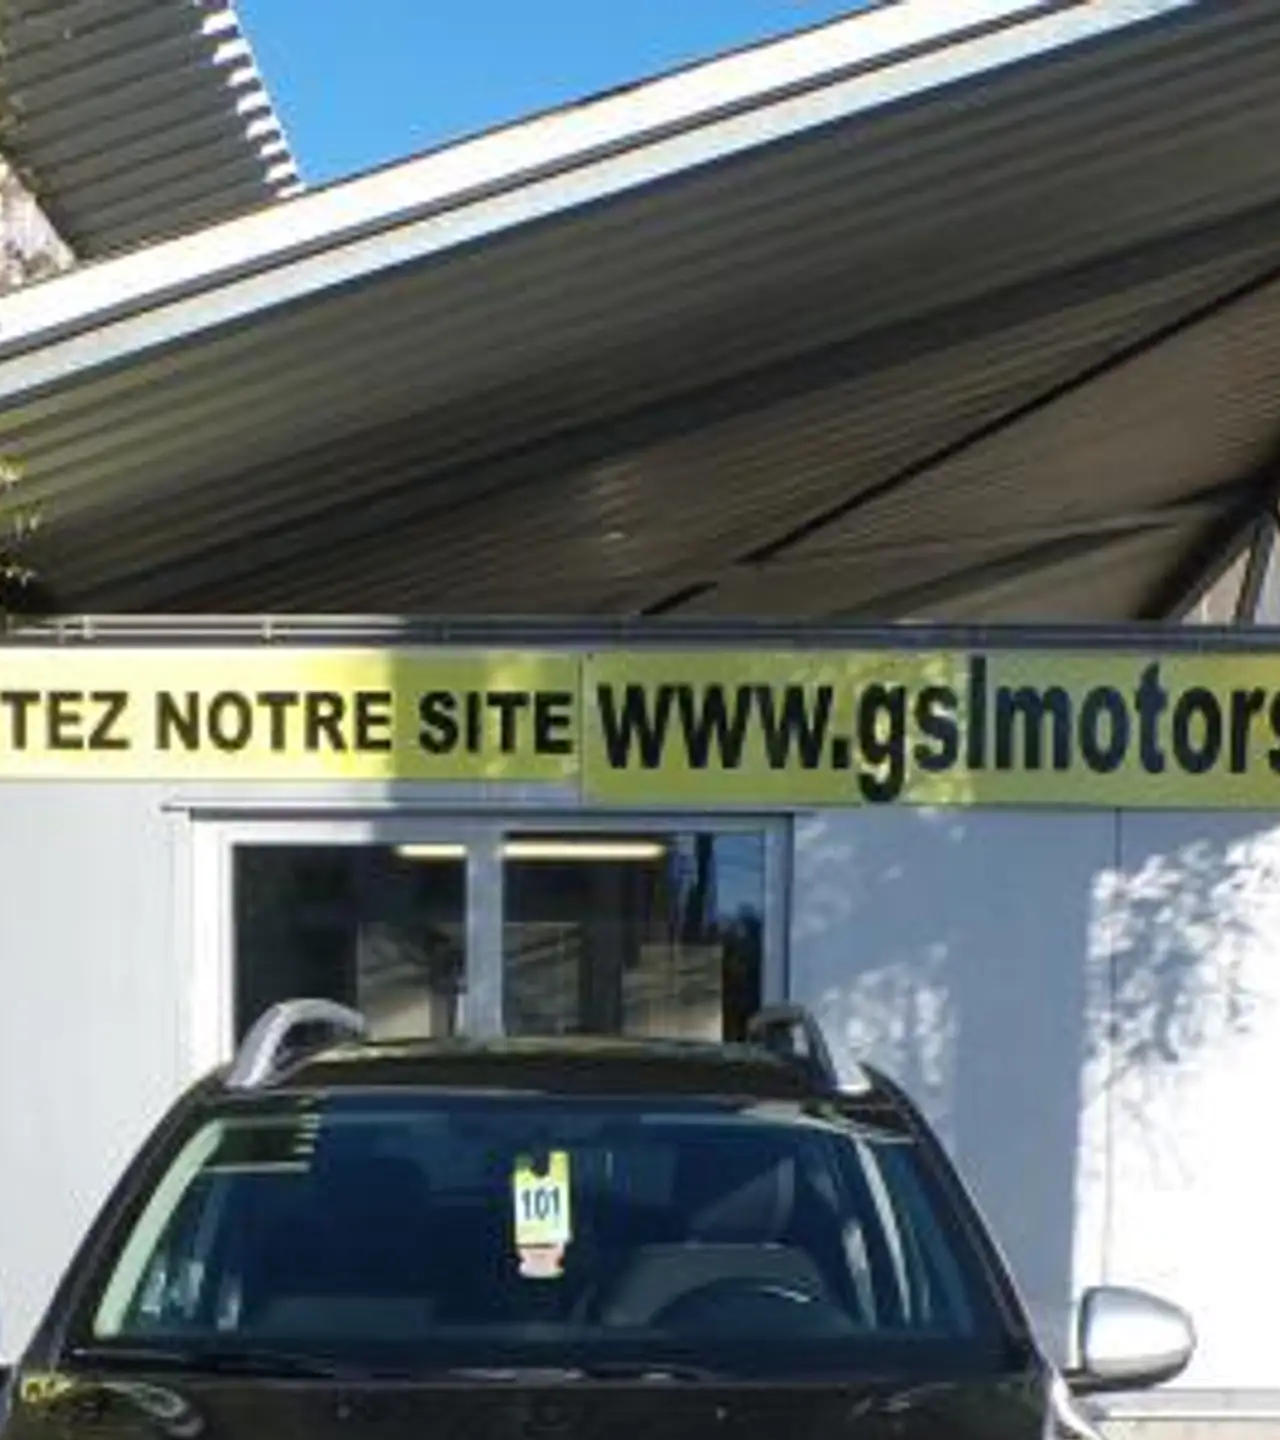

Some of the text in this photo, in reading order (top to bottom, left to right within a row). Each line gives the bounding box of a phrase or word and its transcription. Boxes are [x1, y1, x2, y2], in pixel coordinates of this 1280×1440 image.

[155, 690, 393, 753] NOTRE
[418, 690, 574, 755] SITE
[521, 1186, 561, 1222] 101
